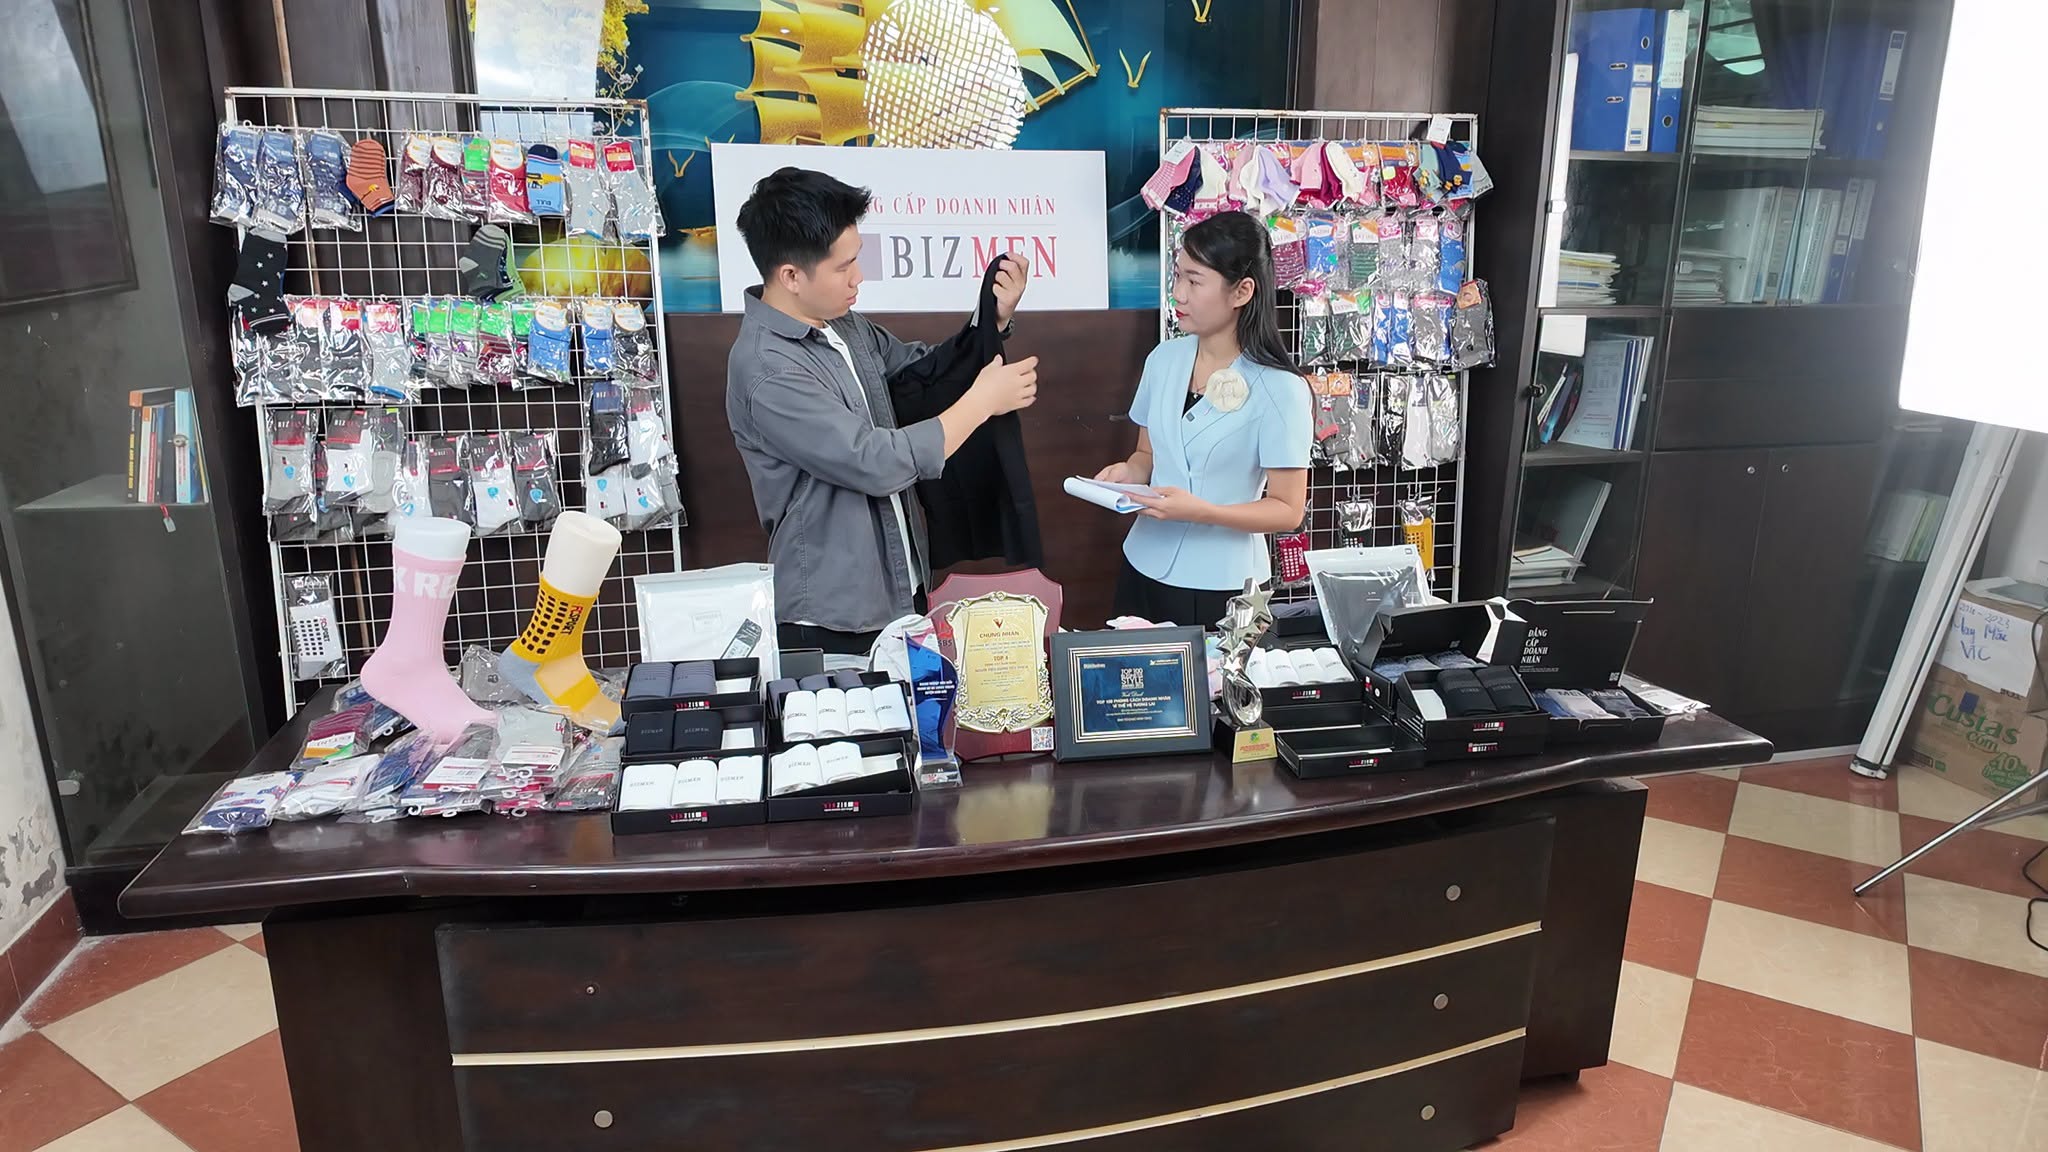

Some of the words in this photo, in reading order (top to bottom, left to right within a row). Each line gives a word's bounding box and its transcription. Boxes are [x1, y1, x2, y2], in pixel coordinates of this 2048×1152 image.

[893, 192, 926, 214] CẤP
[936, 197, 997, 215] DOANH
[1007, 195, 1056, 215] NHÂN
[1985, 613, 2011, 629] 2023
